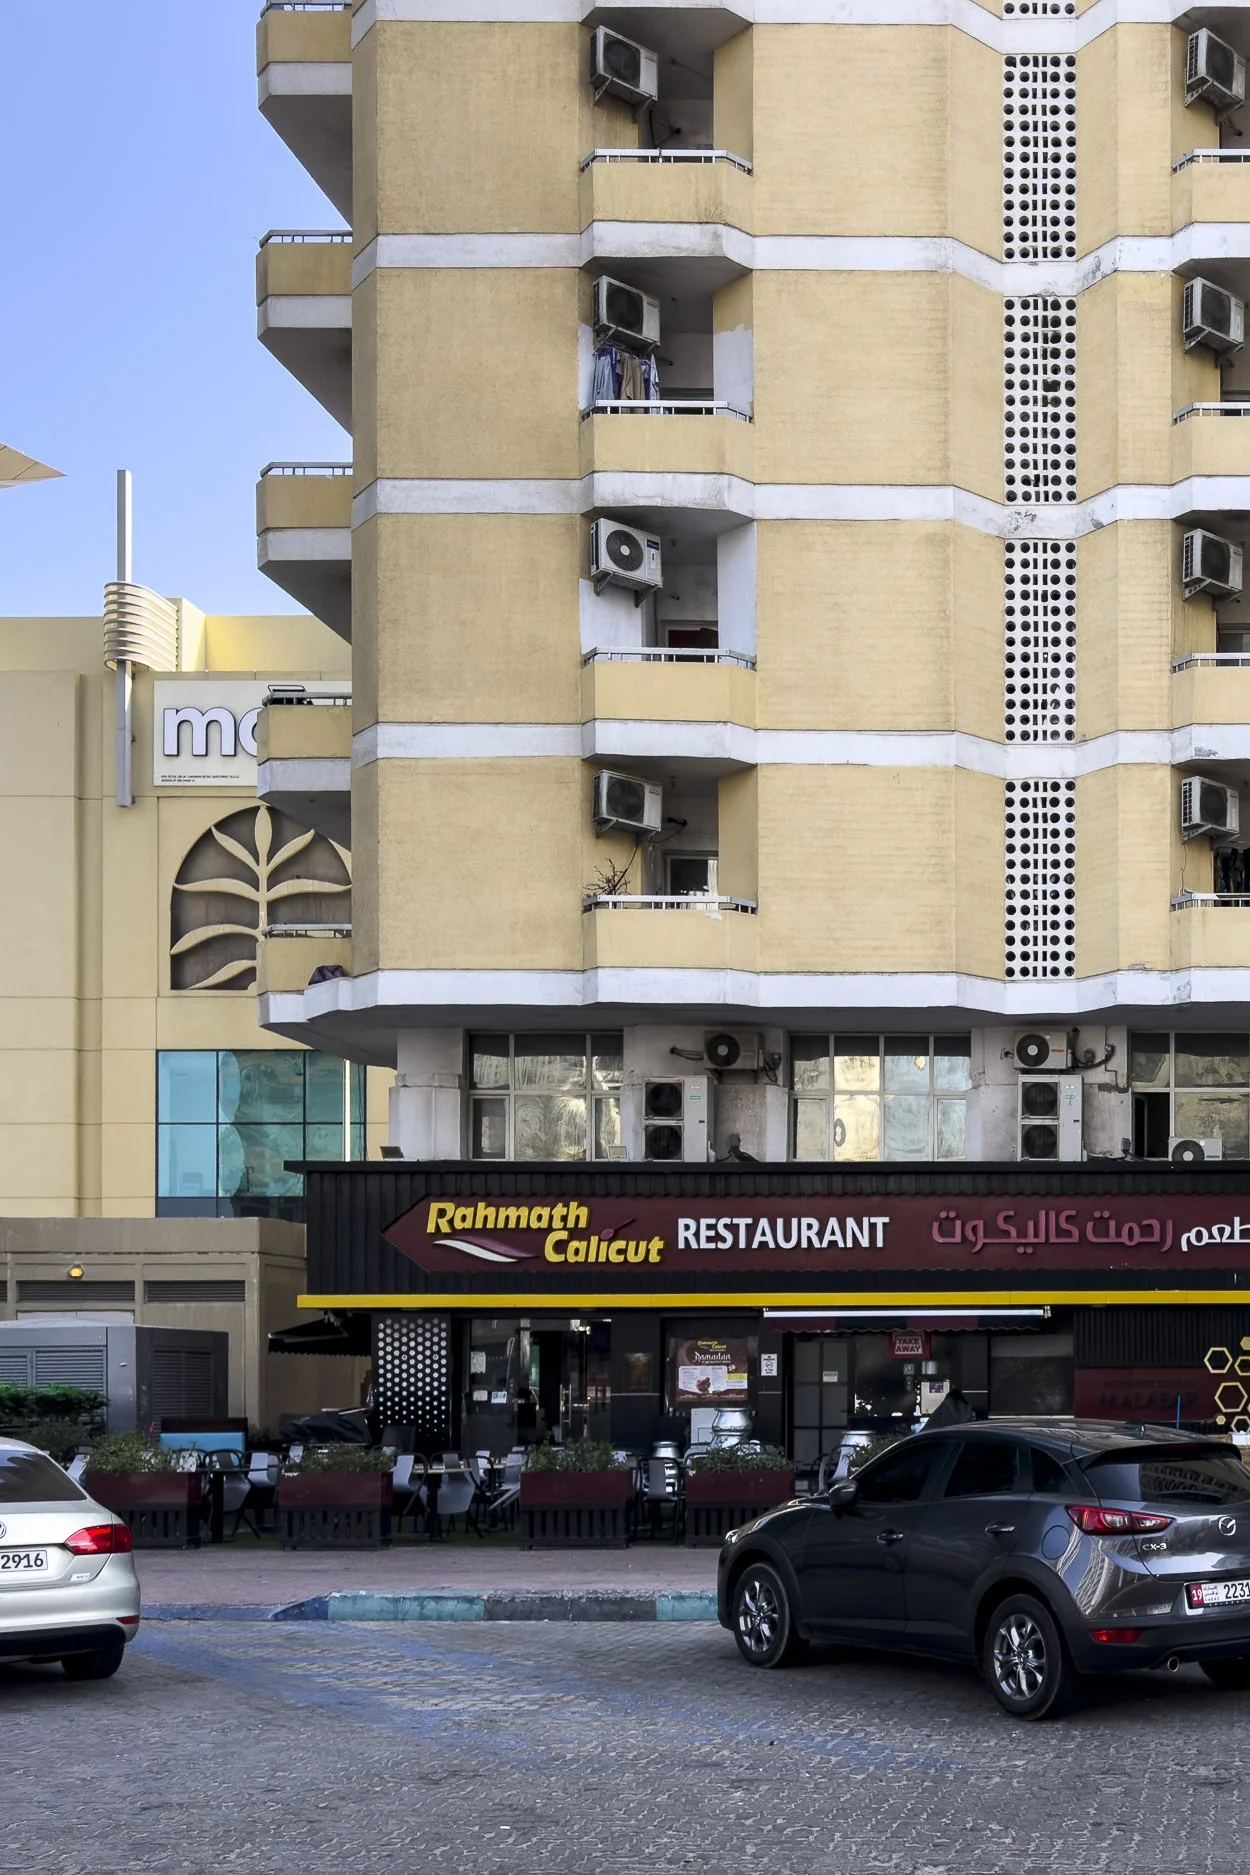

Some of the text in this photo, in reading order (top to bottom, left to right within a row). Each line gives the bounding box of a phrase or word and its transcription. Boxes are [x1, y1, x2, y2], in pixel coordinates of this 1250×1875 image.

[425, 1201, 590, 1235] Rahmath
[676, 1216, 890, 1250] RESTAURANT
[931, 1209, 1080, 1255] كاليكوت
[1085, 1210, 1174, 1253] رحمت
[543, 1230, 665, 1265] Calicut
[895, 1344, 922, 1353] AWAY
[896, 1336, 920, 1345] TAKE
[692, 1351, 731, 1363] Ramadan
[1142, 1542, 1167, 1551] CX-3
[0, 1553, 44, 1569] 2916
[1191, 1588, 1203, 1601] 19
